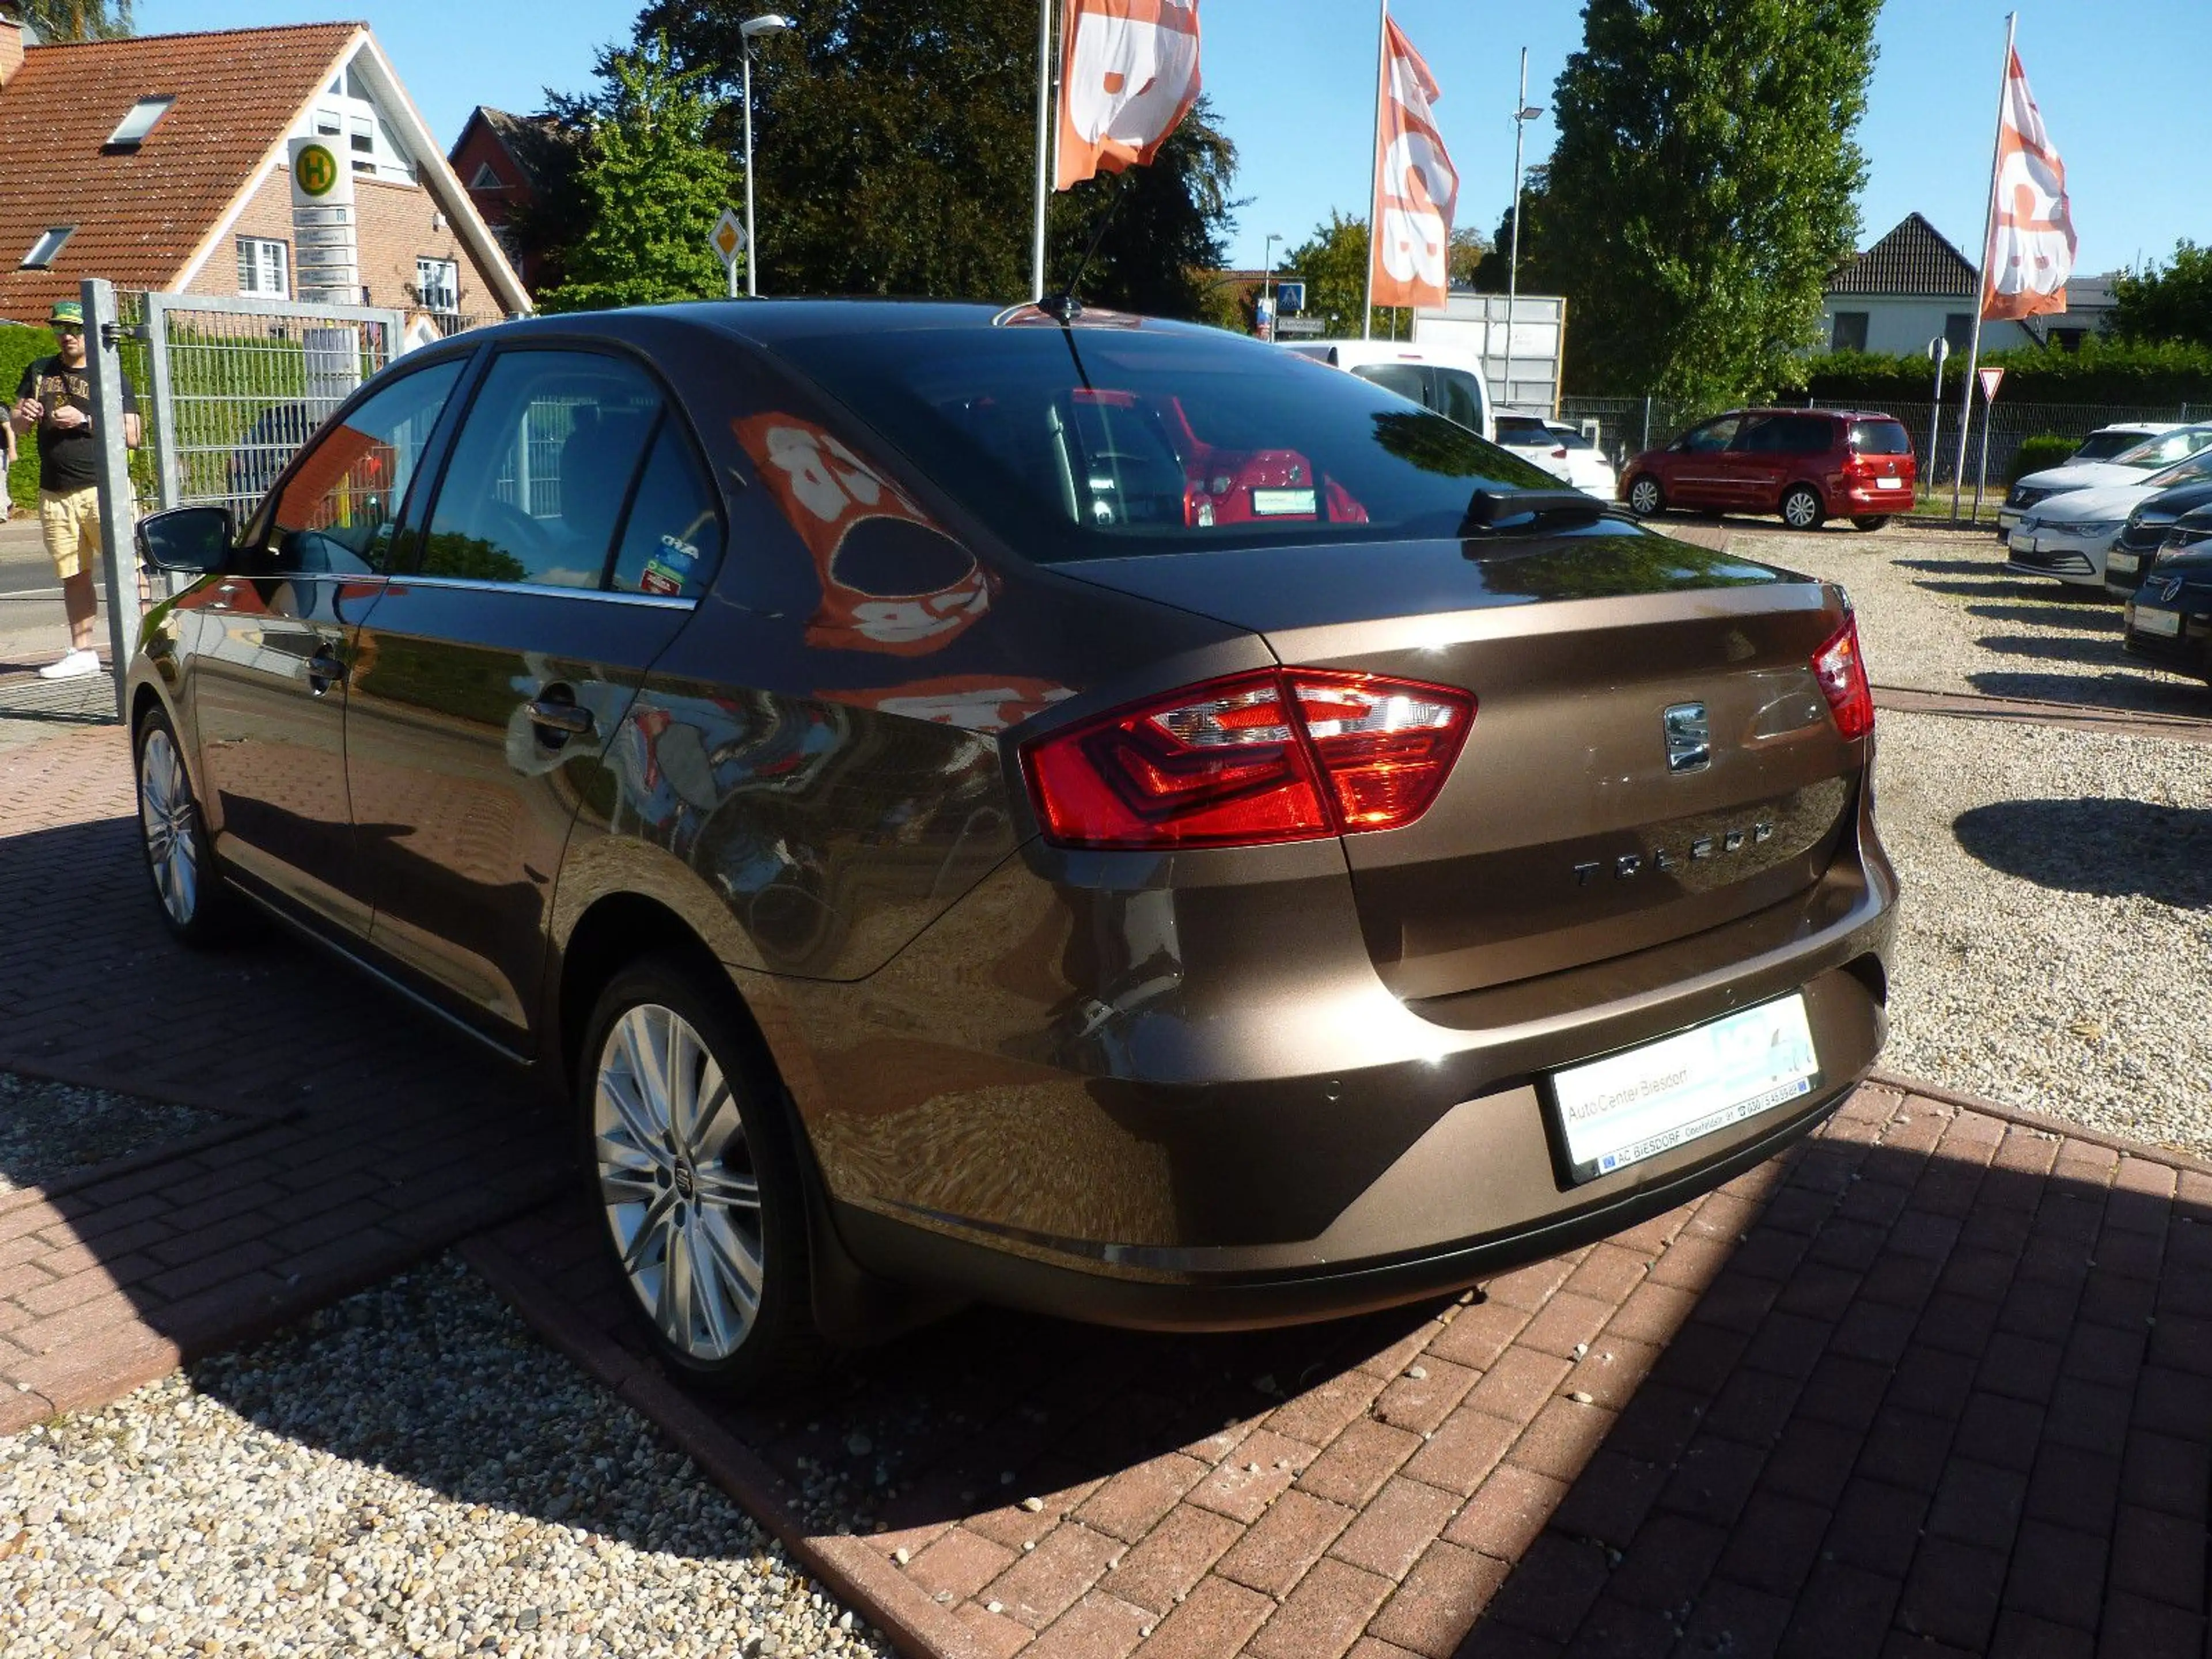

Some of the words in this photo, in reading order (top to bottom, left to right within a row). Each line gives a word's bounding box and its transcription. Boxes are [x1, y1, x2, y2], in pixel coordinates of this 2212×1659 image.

[305, 157, 325, 184] H
[1571, 822, 1774, 885] TOLEDO
[1618, 1150, 1631, 1163] AC
[1634, 1130, 1680, 1158] BIESDORF
